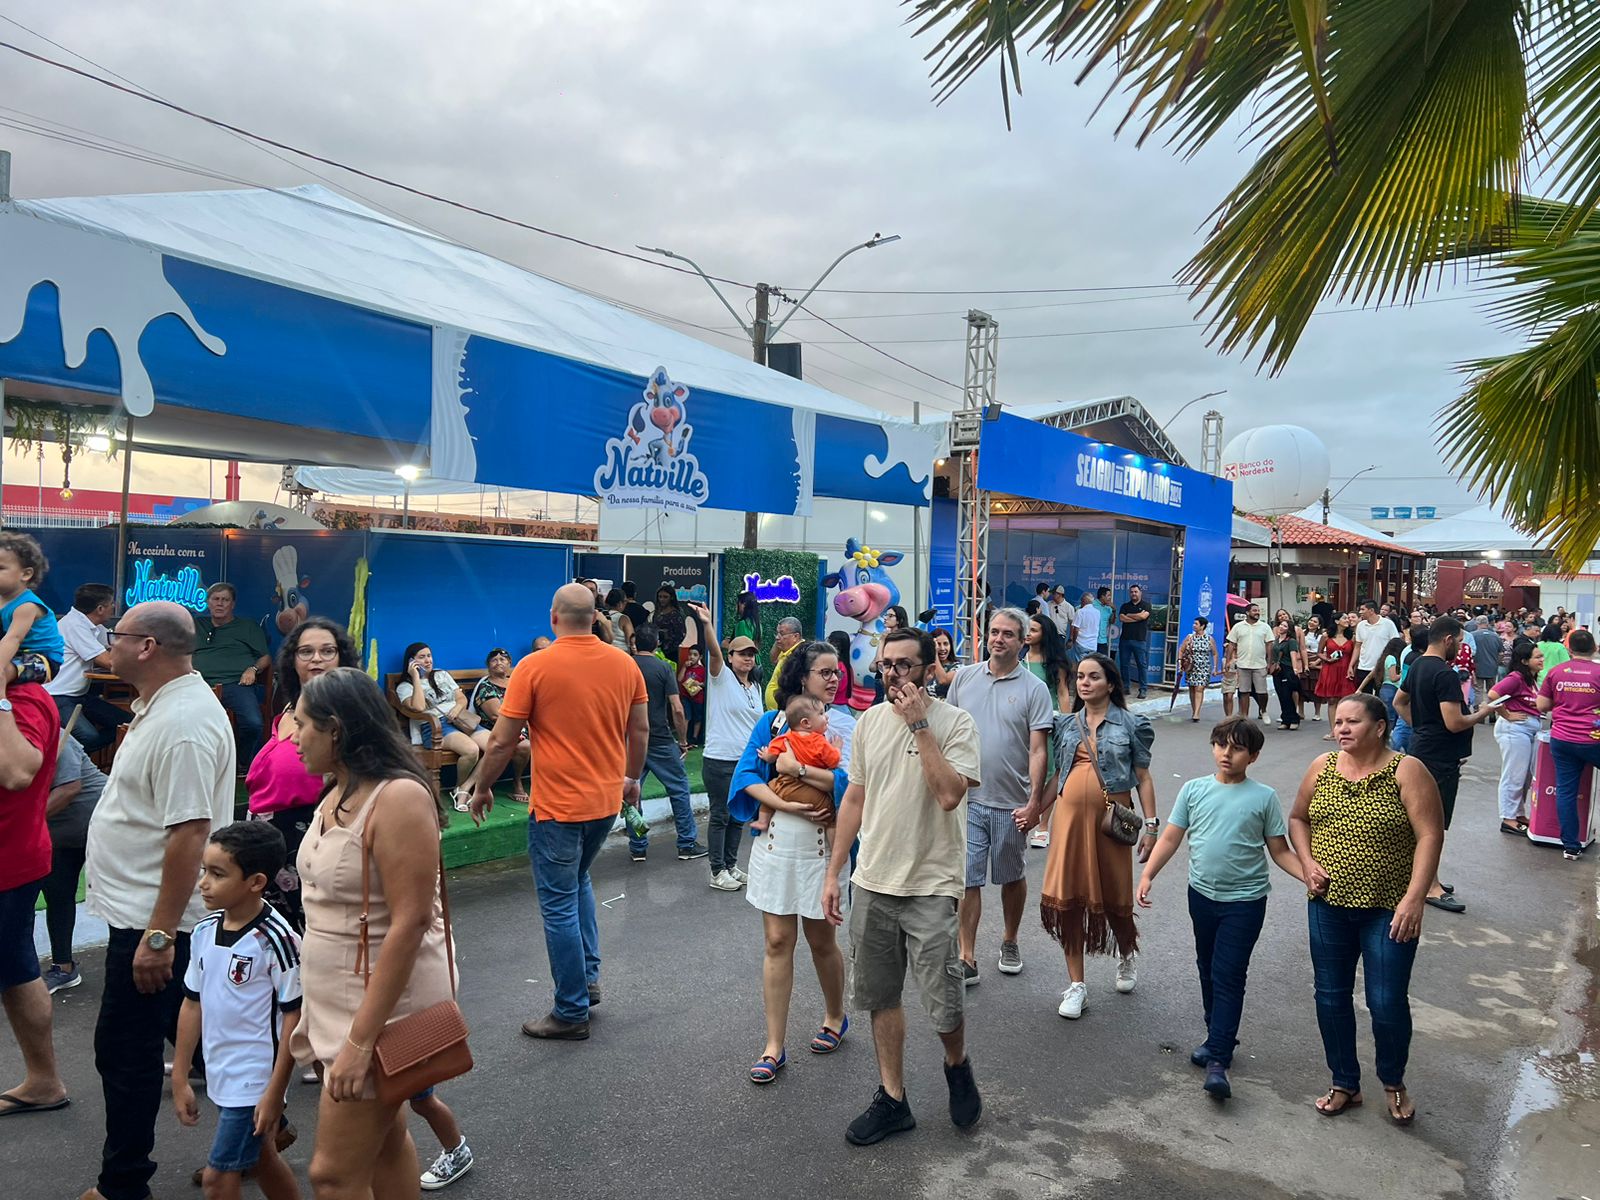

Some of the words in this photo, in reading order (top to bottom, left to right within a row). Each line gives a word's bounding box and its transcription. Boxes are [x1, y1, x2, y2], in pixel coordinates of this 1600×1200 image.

[600, 445, 704, 498] Natville
[1239, 461, 1261, 469] Banco
[1239, 467, 1274, 476] Nordeste
[1076, 453, 1115, 493] SEAGRI
[1123, 465, 1170, 505] EXPOAGRO
[607, 494, 620, 504] Da
[621, 496, 640, 504] nossa
[664, 499, 680, 509] para
[128, 541, 141, 555] Na
[143, 544, 175, 556] cozinha
[178, 549, 196, 557] com
[198, 549, 205, 557] a
[663, 566, 702, 576] Produtos
[1023, 560, 1056, 574] 154
[1115, 571, 1149, 581] milhões
[126, 559, 206, 612] Natville
